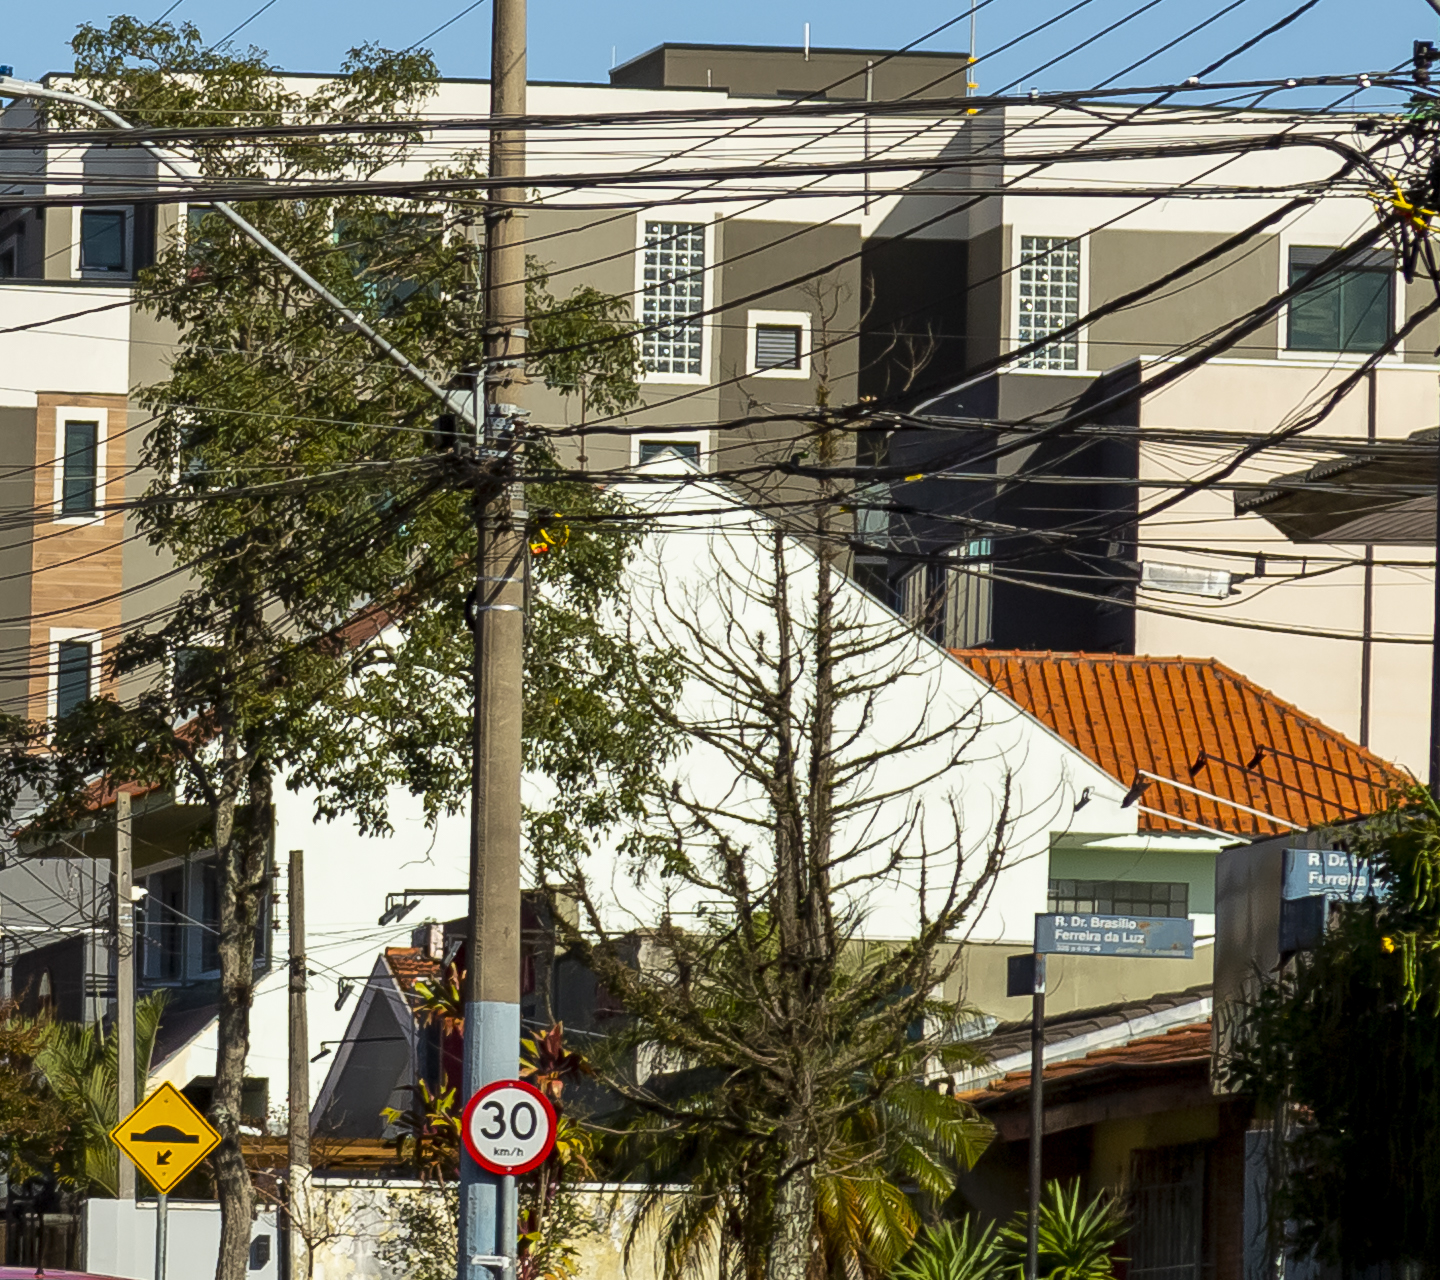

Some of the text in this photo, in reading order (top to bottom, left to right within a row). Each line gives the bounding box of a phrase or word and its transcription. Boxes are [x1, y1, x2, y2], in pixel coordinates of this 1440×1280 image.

[1054, 916, 1137, 929] R. Dr. Brasílio
[1054, 929, 1145, 944] Ferreira da Luz
[480, 1100, 538, 1141] 30
[493, 1147, 524, 1157] km/h
